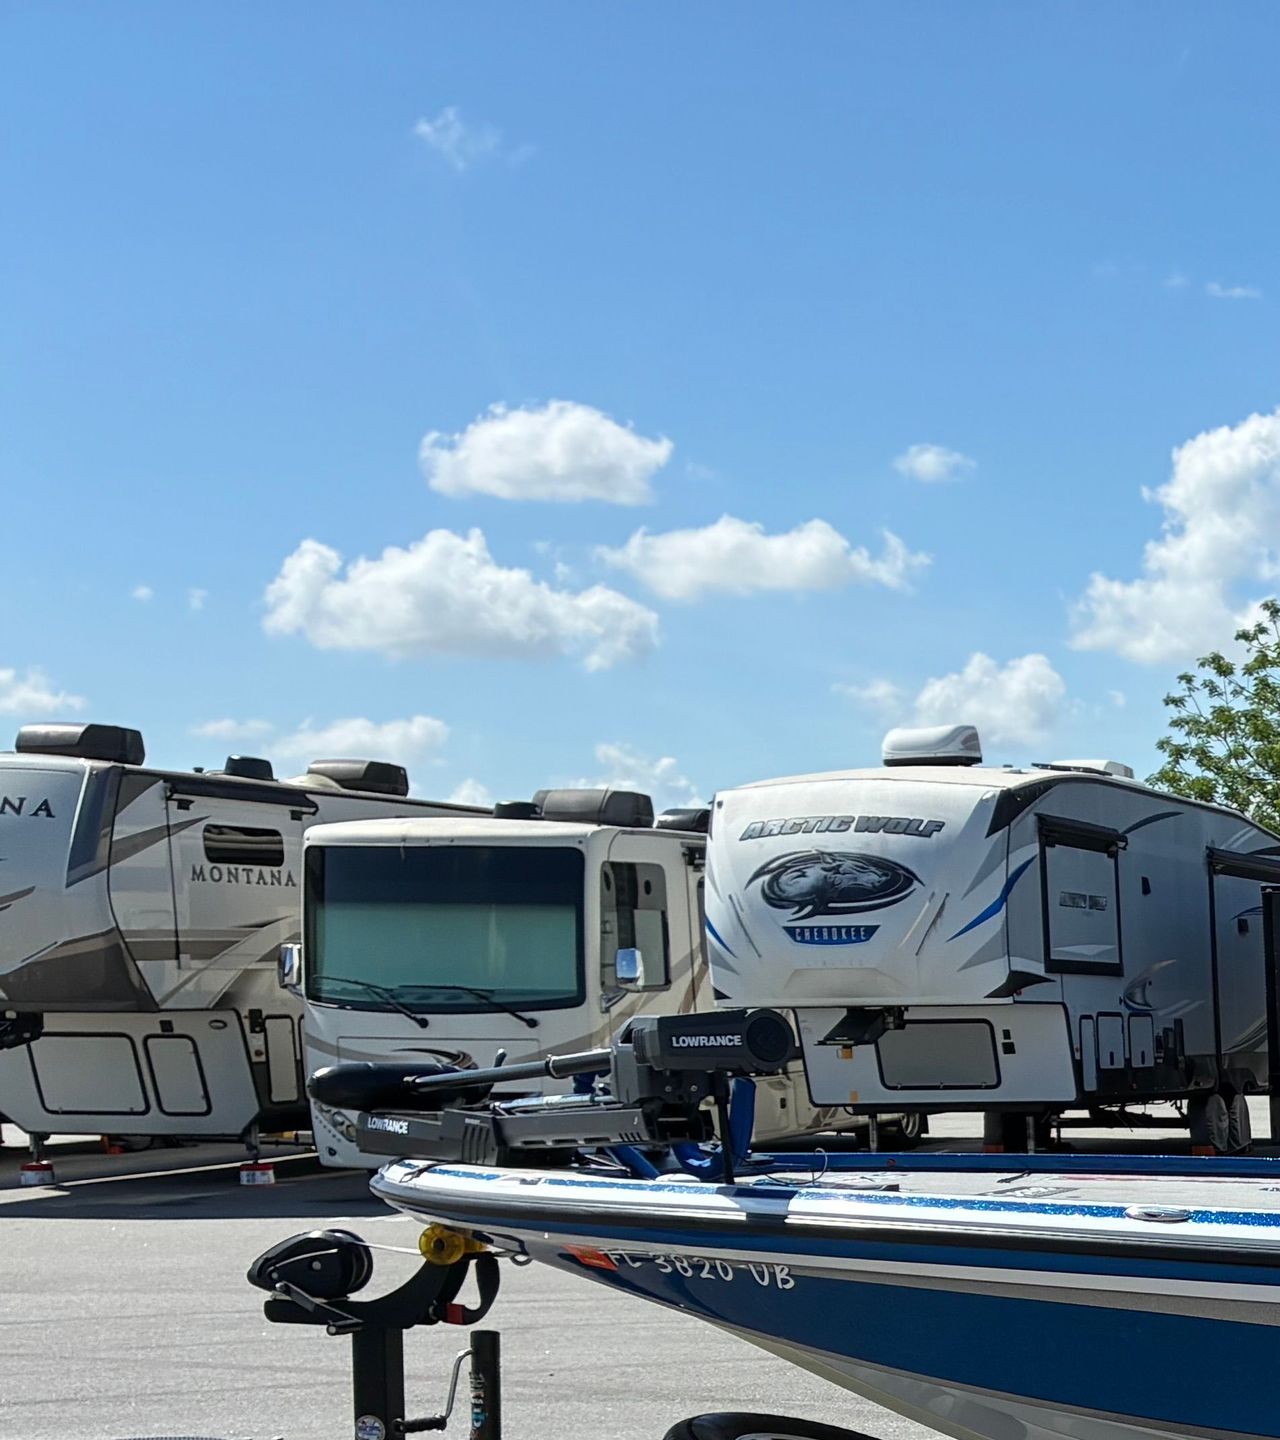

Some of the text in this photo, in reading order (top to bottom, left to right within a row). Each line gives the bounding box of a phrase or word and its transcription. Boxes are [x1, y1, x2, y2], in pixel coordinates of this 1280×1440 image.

[739, 816, 945, 841] ARCTIC WOLF
[190, 864, 297, 887] MONTANA
[794, 927, 866, 941] CHEROKEE
[671, 1034, 743, 1049] LOWRANCE
[366, 1116, 409, 1136] LOWRANCE
[654, 1253, 734, 1281] 3820
[749, 1262, 795, 1290] UB
